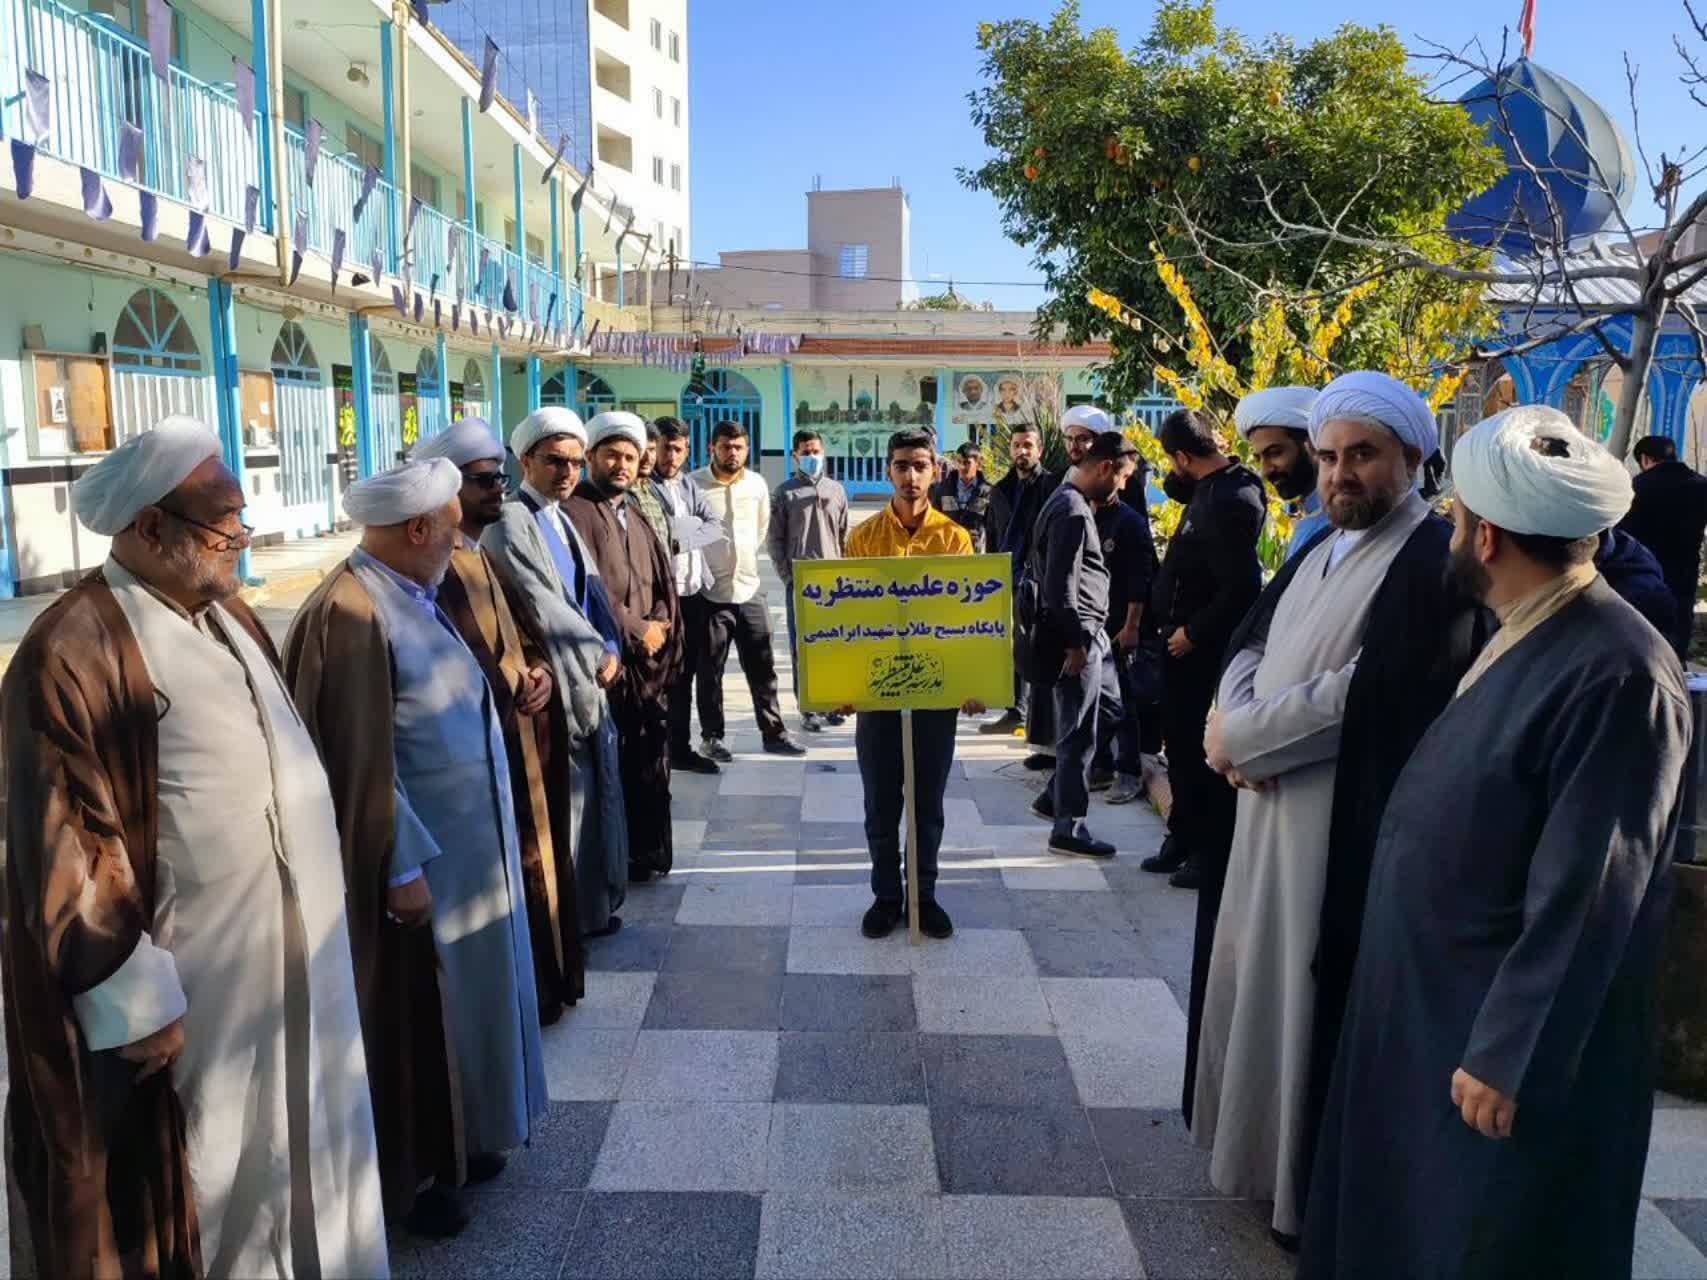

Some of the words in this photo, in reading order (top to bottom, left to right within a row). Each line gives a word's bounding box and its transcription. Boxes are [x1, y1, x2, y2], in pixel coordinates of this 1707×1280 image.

[802, 576, 884, 607] منتظریه
[888, 574, 943, 602] علمیه
[947, 577, 1003, 602] حوزه
[804, 623, 861, 643] ابراهیمی
[862, 623, 895, 640] شهید
[897, 620, 931, 640] طلاب
